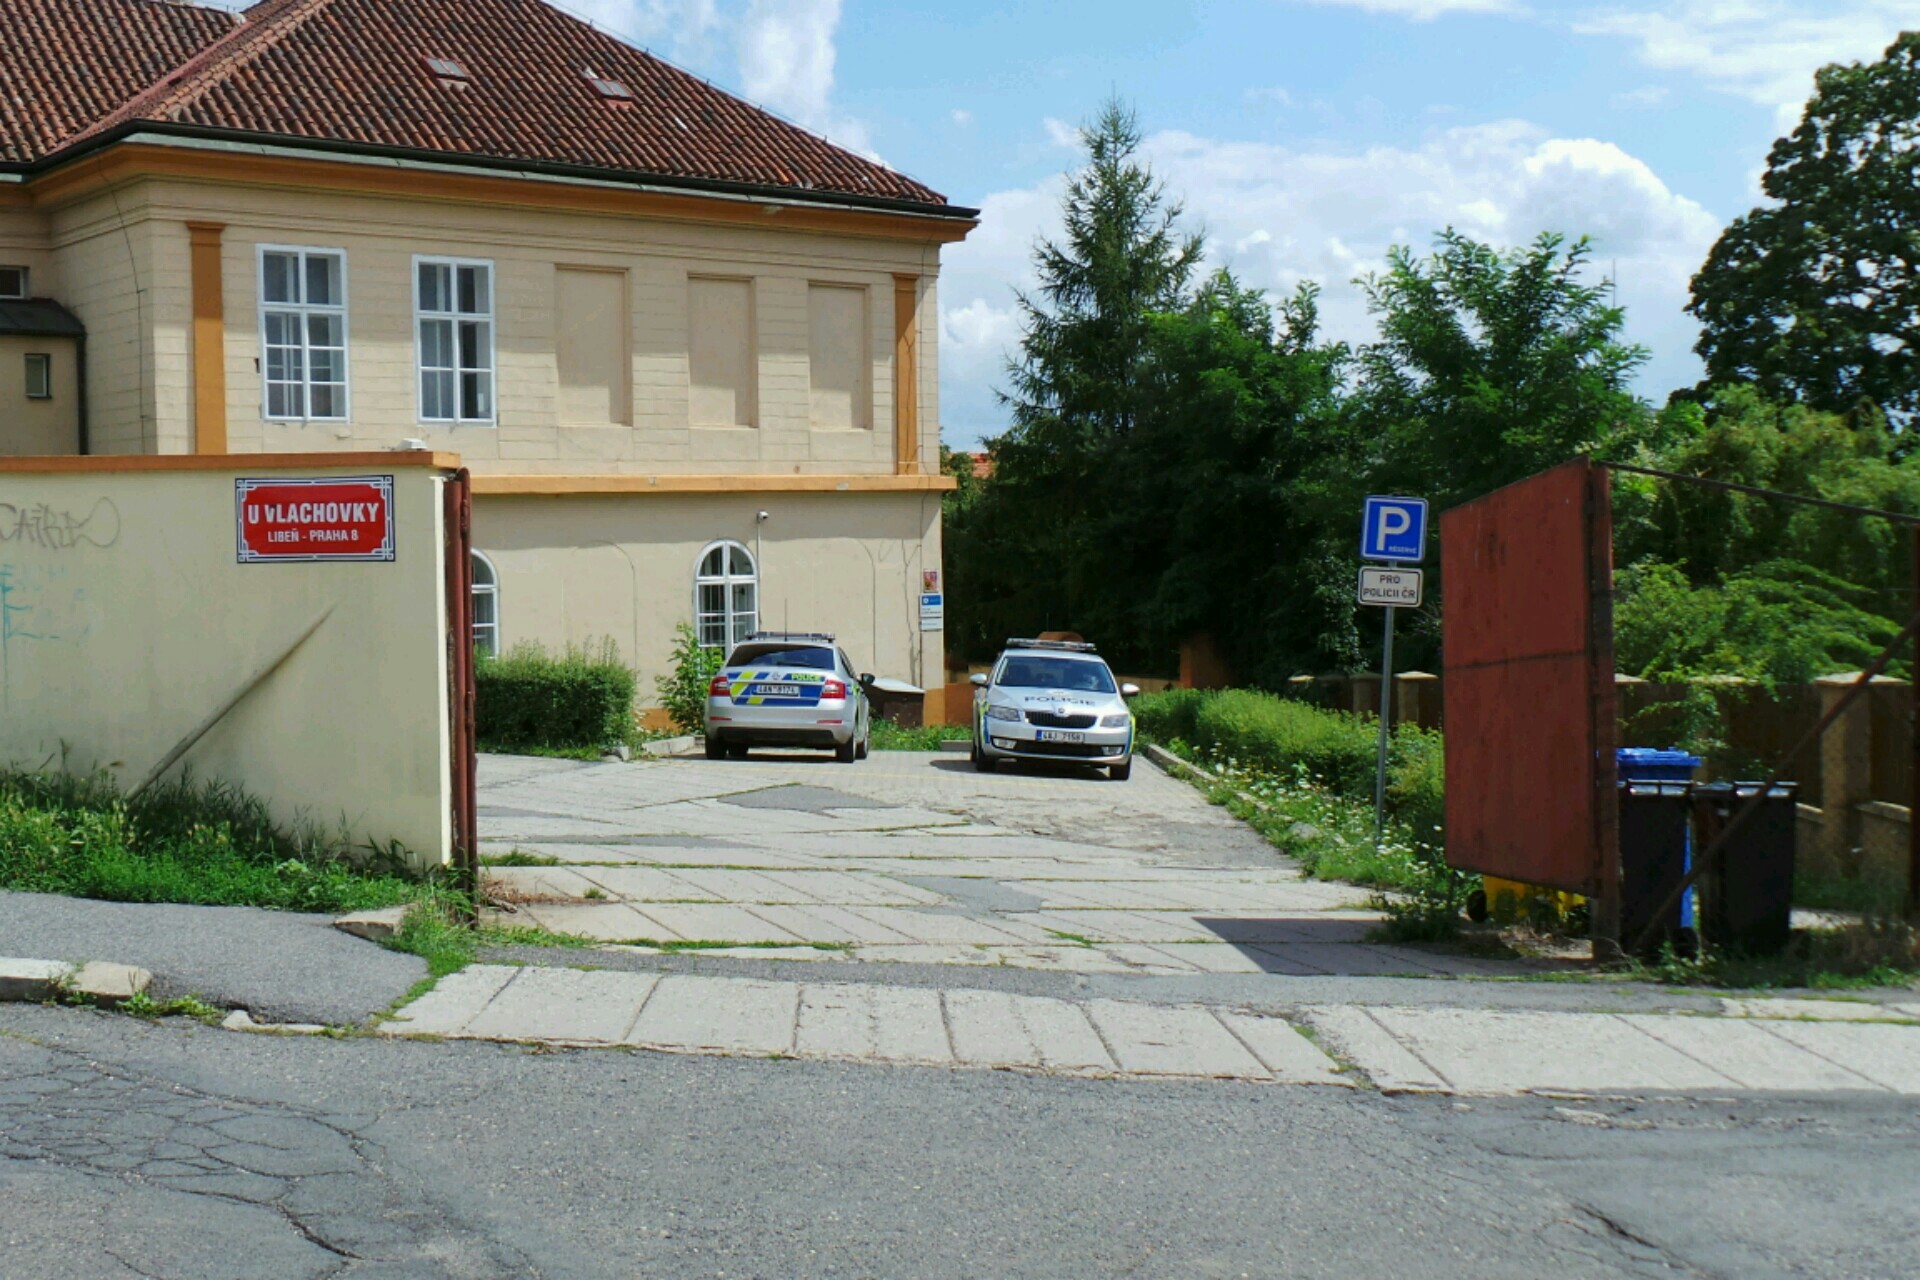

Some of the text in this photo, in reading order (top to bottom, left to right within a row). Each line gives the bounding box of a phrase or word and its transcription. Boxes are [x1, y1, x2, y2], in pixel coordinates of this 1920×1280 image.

[247, 503, 379, 524] U VLACHOVKY
[268, 528, 299, 542] LIBEŇ
[309, 530, 349, 542] PRAHA
[351, 529, 359, 541] 8
[1376, 506, 1411, 551] P
[1379, 574, 1400, 584] PRO
[1363, 586, 1416, 599] POLICII ČR
[1024, 696, 1096, 706] POLICIE
